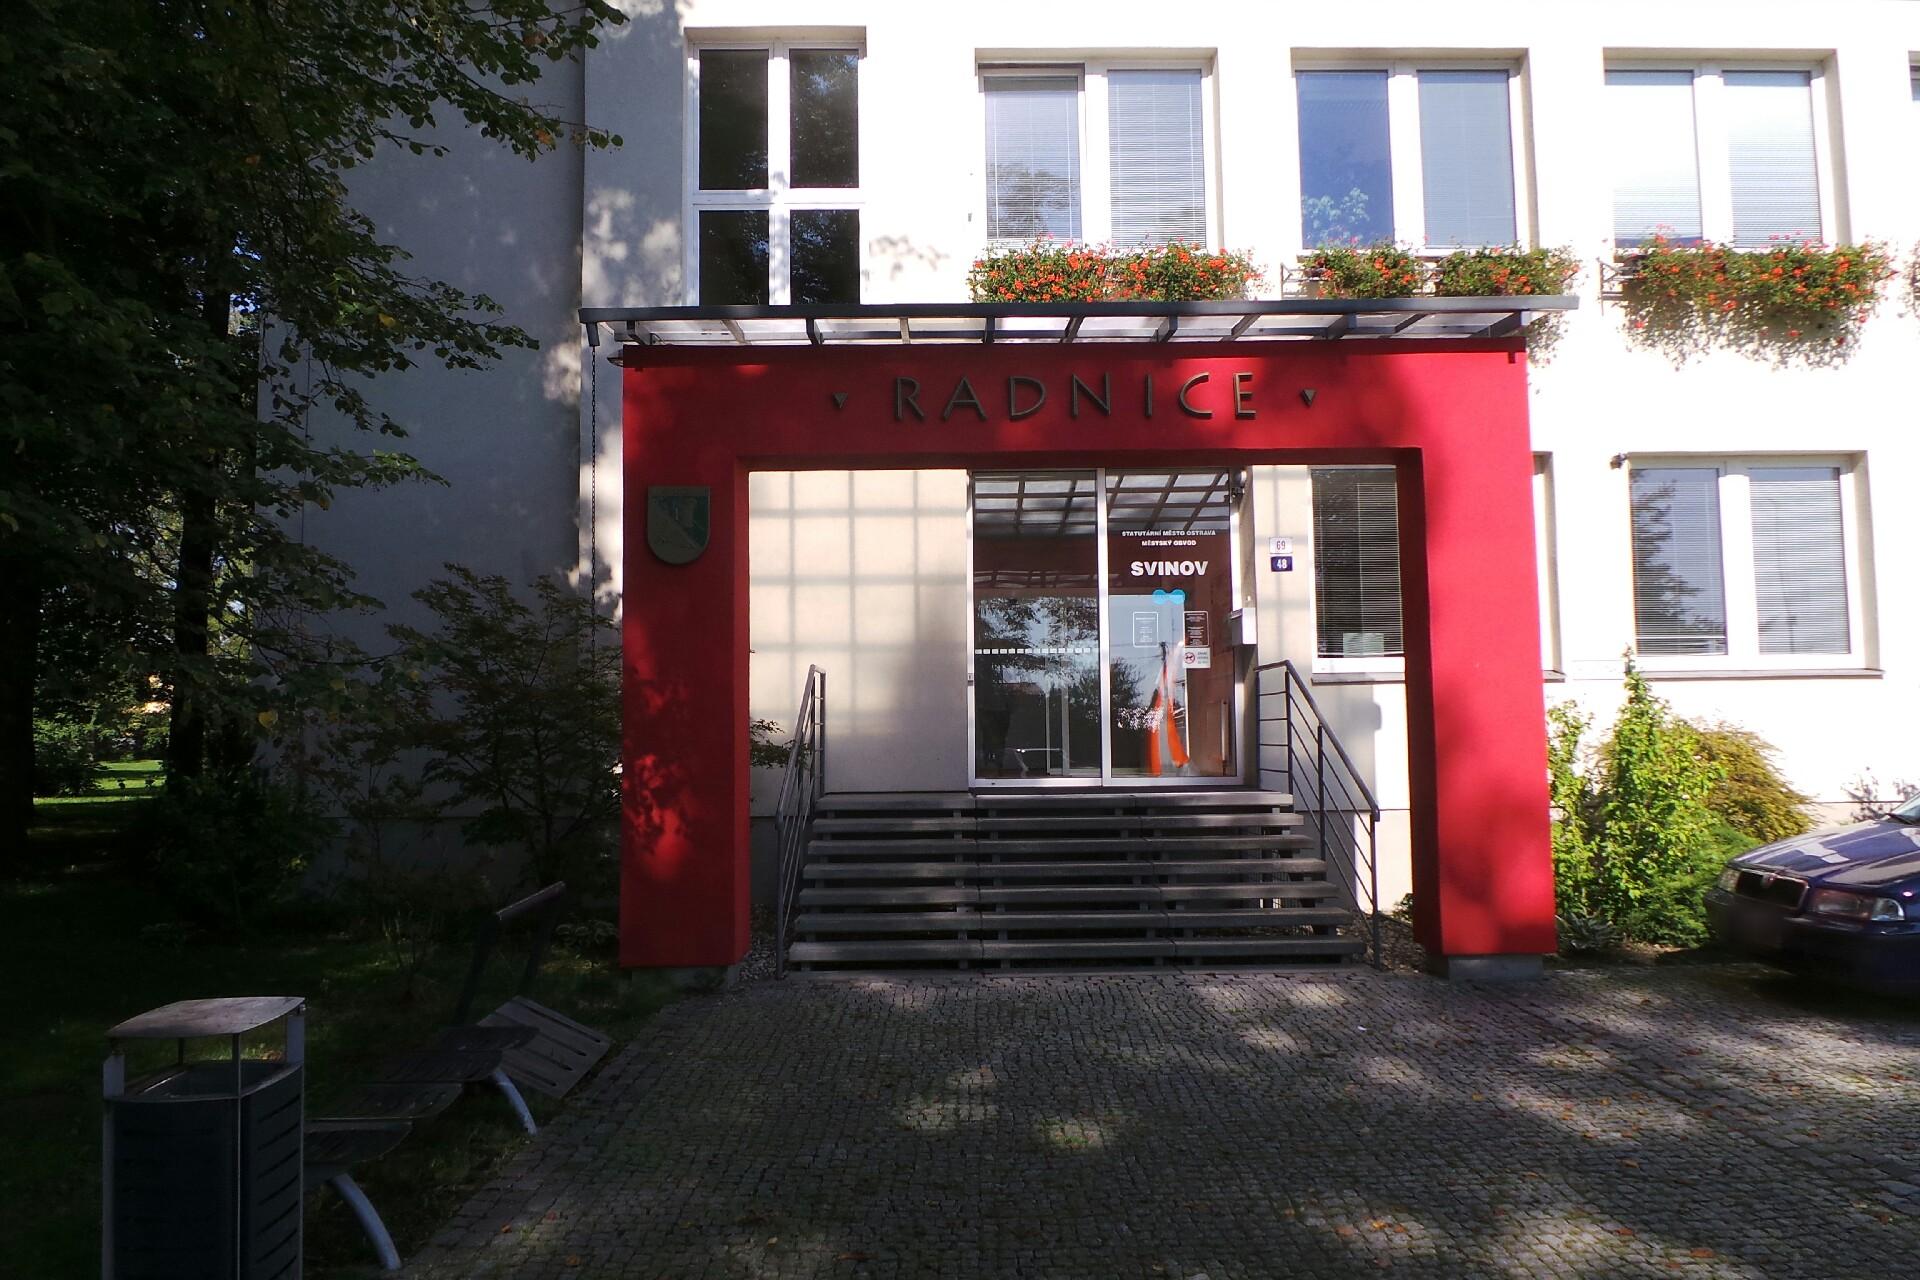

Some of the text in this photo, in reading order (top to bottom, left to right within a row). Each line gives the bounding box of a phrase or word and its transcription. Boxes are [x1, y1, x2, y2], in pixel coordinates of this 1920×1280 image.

[895, 372, 1257, 422] RADNICE
[1276, 540, 1286, 550] 69
[1131, 560, 1208, 577] SVINOV
[1277, 559, 1287, 569] 48
